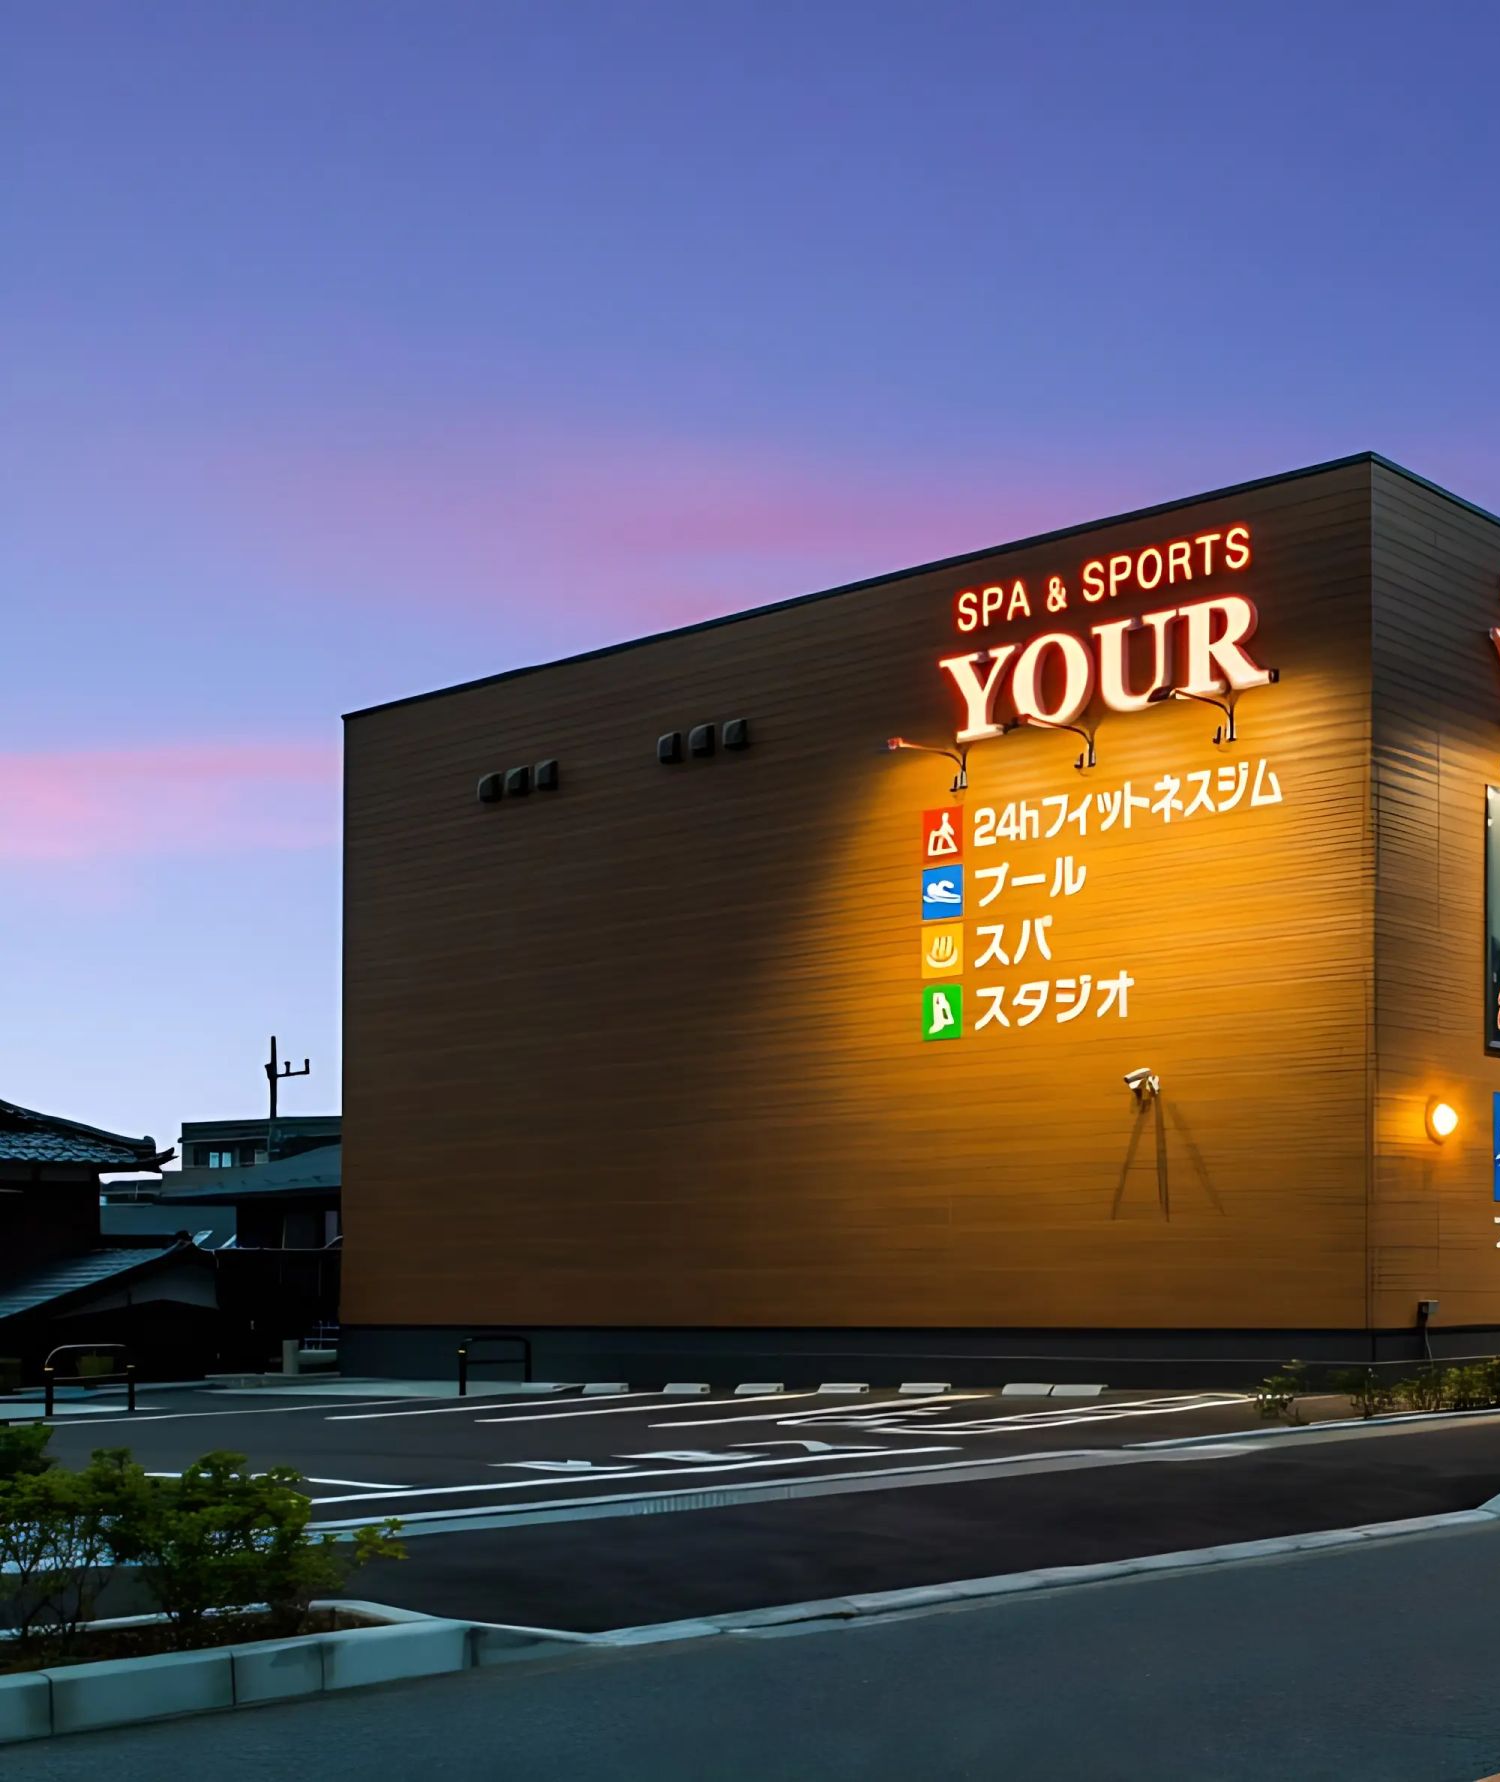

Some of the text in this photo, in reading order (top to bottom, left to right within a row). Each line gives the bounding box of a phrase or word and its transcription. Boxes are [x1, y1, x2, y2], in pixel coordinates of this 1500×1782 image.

[956, 526, 1251, 632] SPA & SPORTS
[939, 596, 1272, 743] YOUR
[972, 758, 1284, 847] 24hフィットネスジム
[973, 914, 1054, 969] スパ
[973, 970, 1135, 1032] スタジオ
